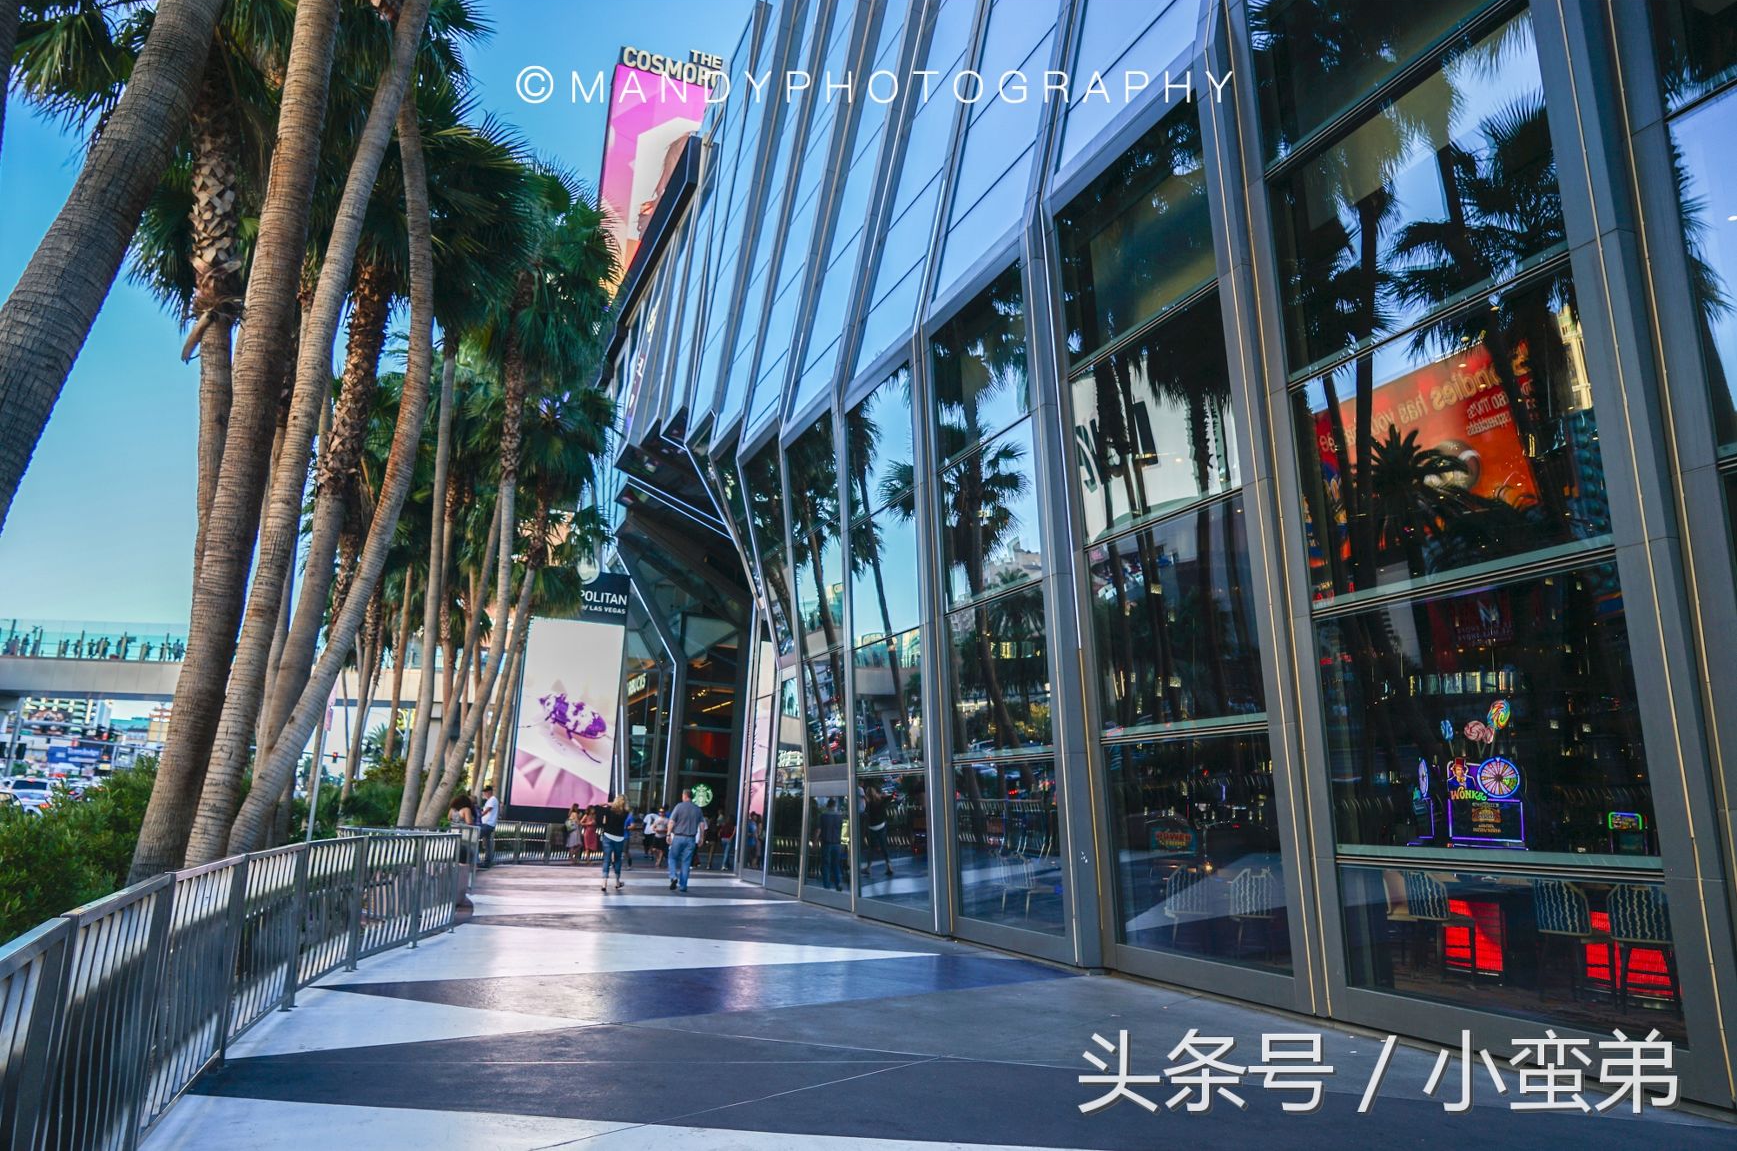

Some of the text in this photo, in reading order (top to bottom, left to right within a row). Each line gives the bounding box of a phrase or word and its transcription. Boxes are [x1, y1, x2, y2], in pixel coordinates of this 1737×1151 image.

[690, 49, 723, 69] THE
[589, 605, 603, 613] LAS
[604, 606, 627, 615] VEGAS
[1450, 786, 1488, 801] WONKA
